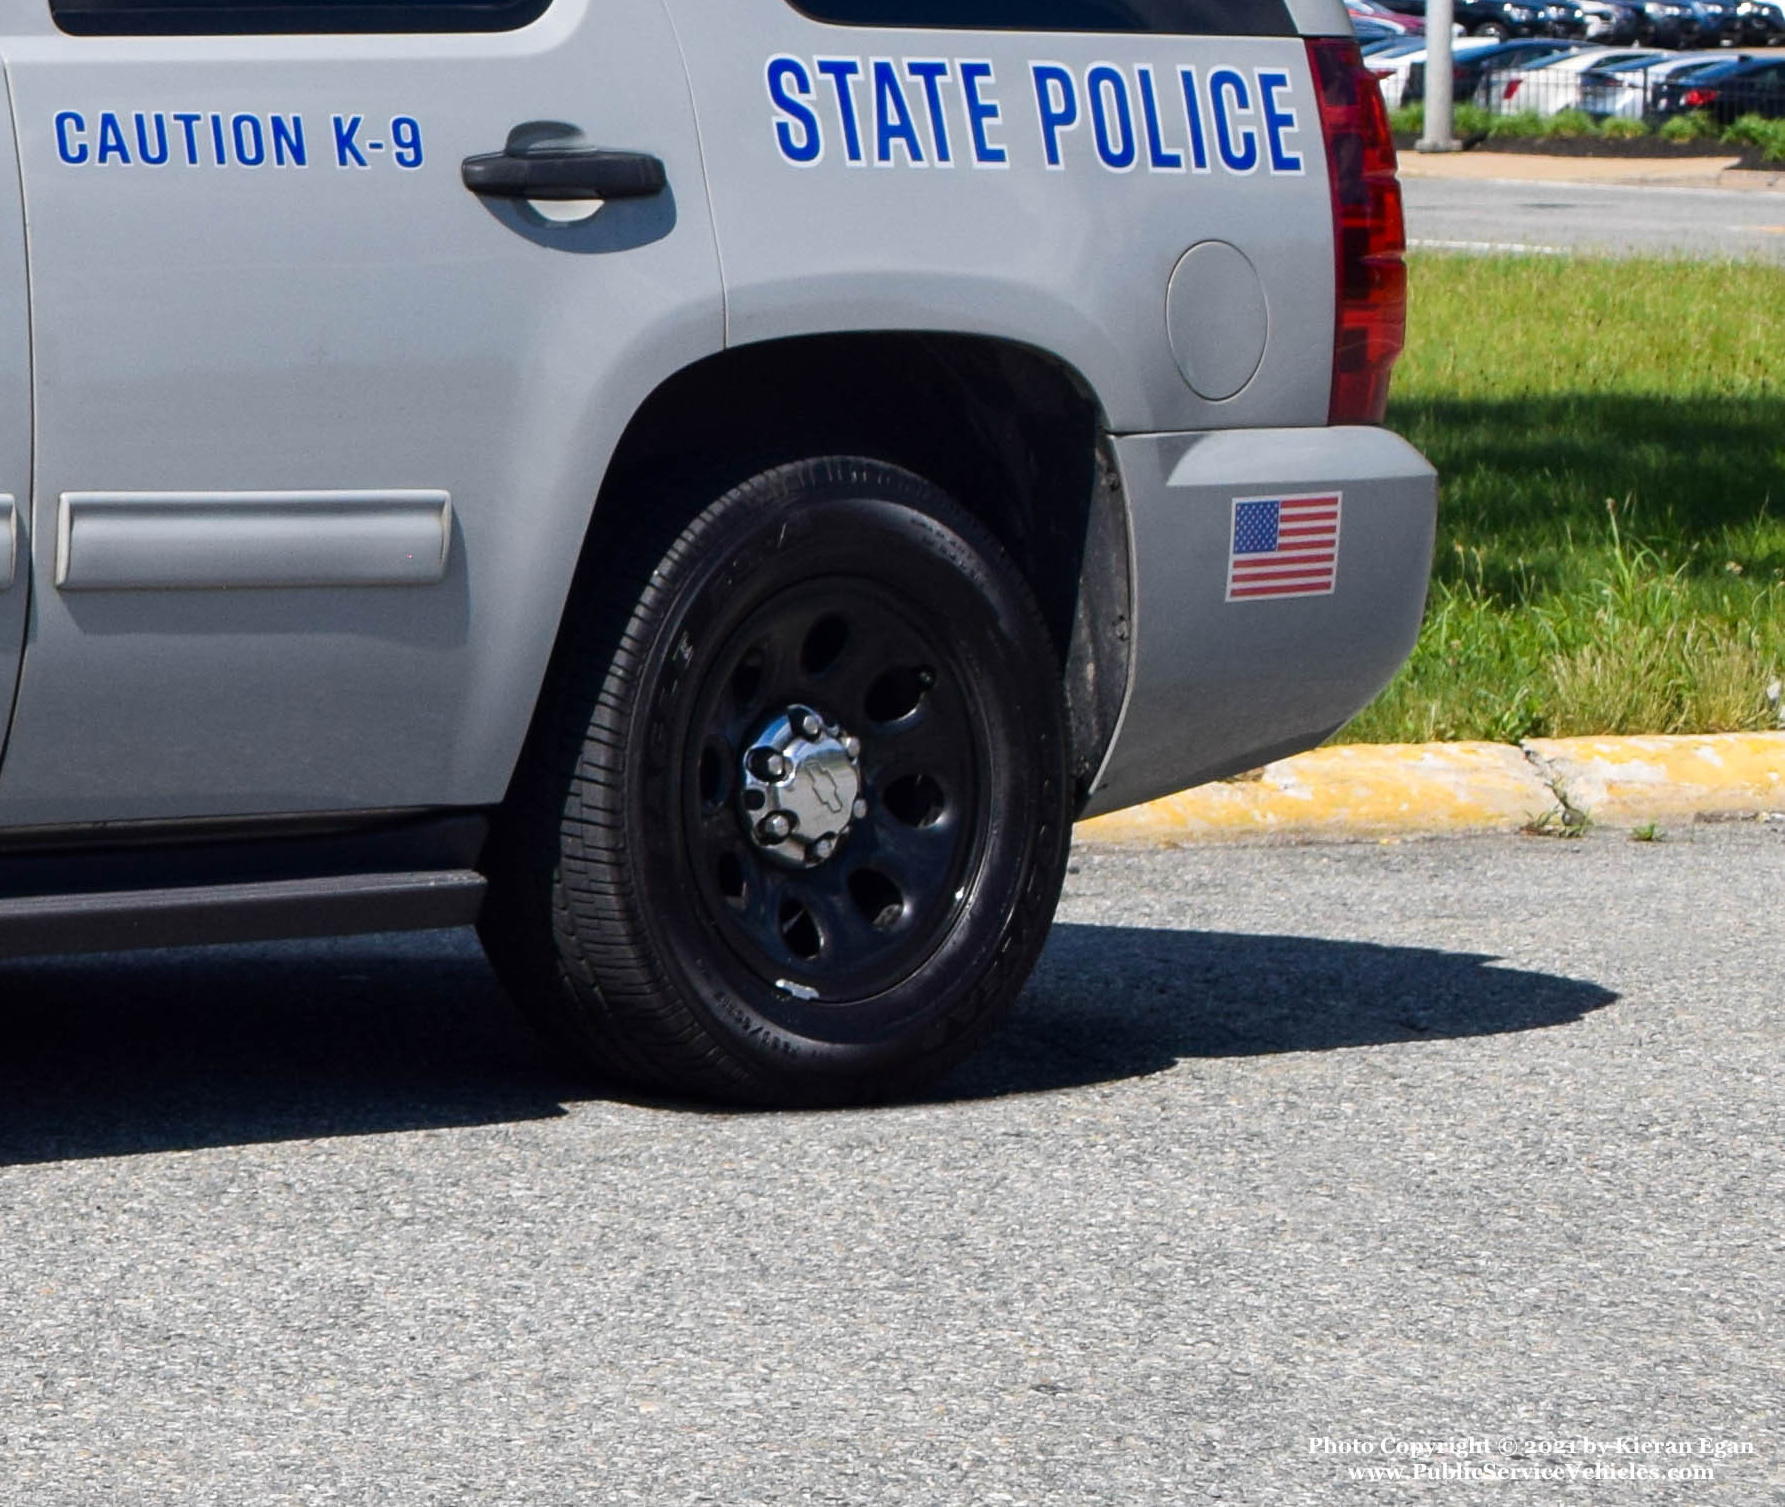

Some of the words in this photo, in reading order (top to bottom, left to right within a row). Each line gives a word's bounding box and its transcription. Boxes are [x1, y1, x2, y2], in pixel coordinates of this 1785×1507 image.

[54, 110, 309, 168] CAUTION
[331, 114, 425, 171] K-9
[765, 53, 1009, 168] STATE
[1028, 59, 1306, 176] POLICE
